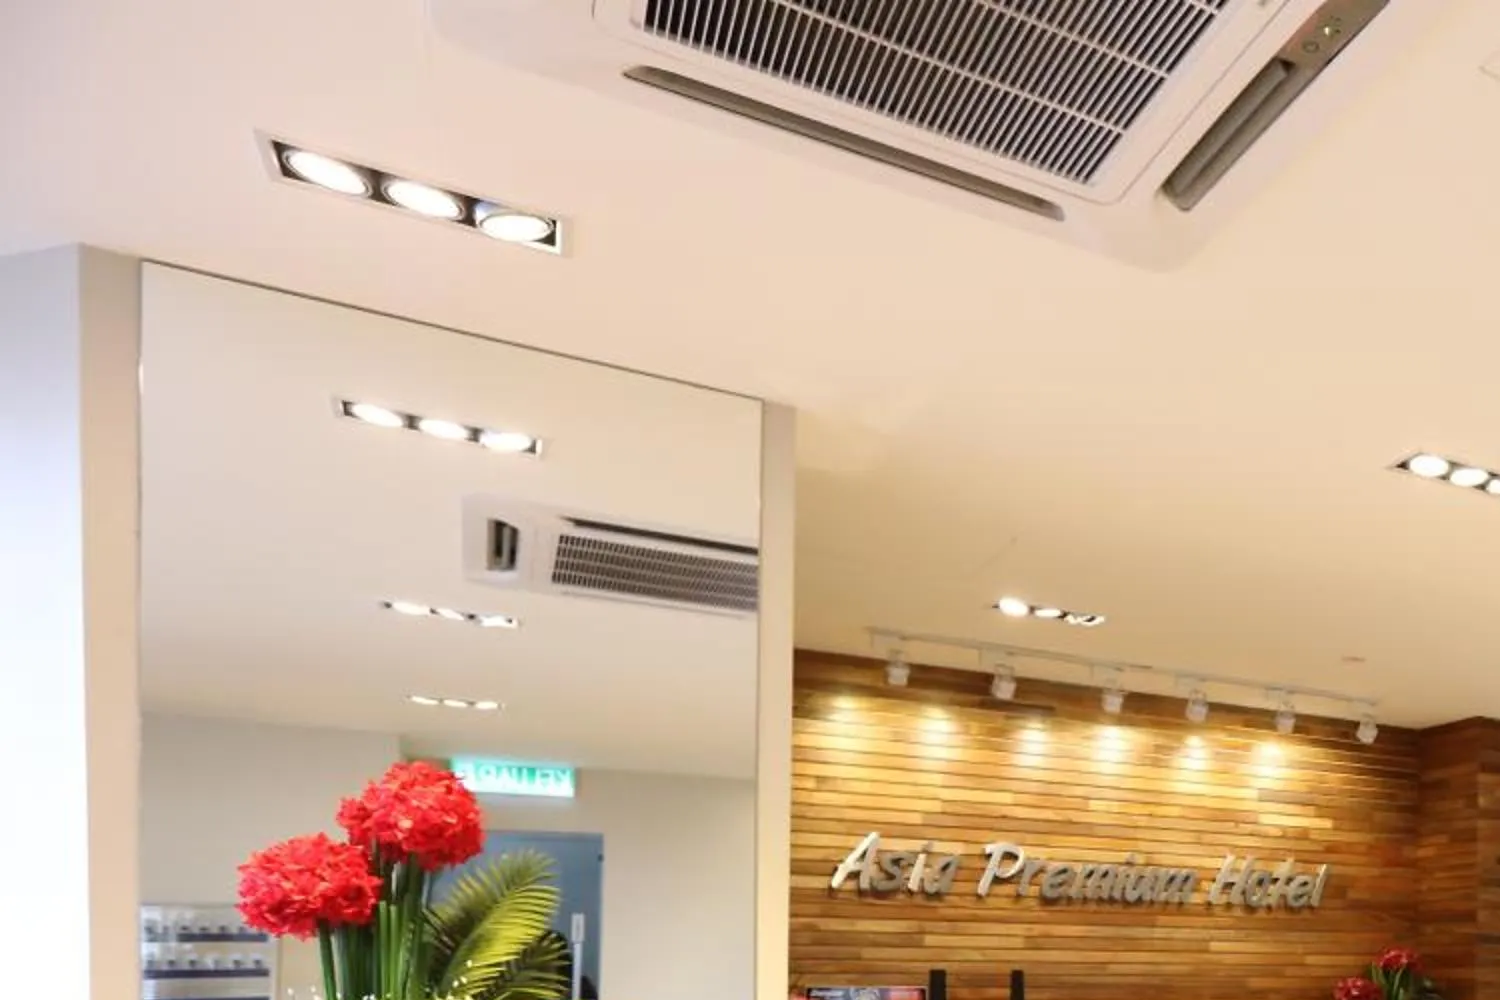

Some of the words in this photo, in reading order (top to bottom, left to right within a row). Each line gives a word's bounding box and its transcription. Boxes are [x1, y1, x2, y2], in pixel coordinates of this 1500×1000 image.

[831, 831, 960, 894] Asia
[976, 841, 1197, 903] Premium
[1208, 853, 1328, 907] Hotel
